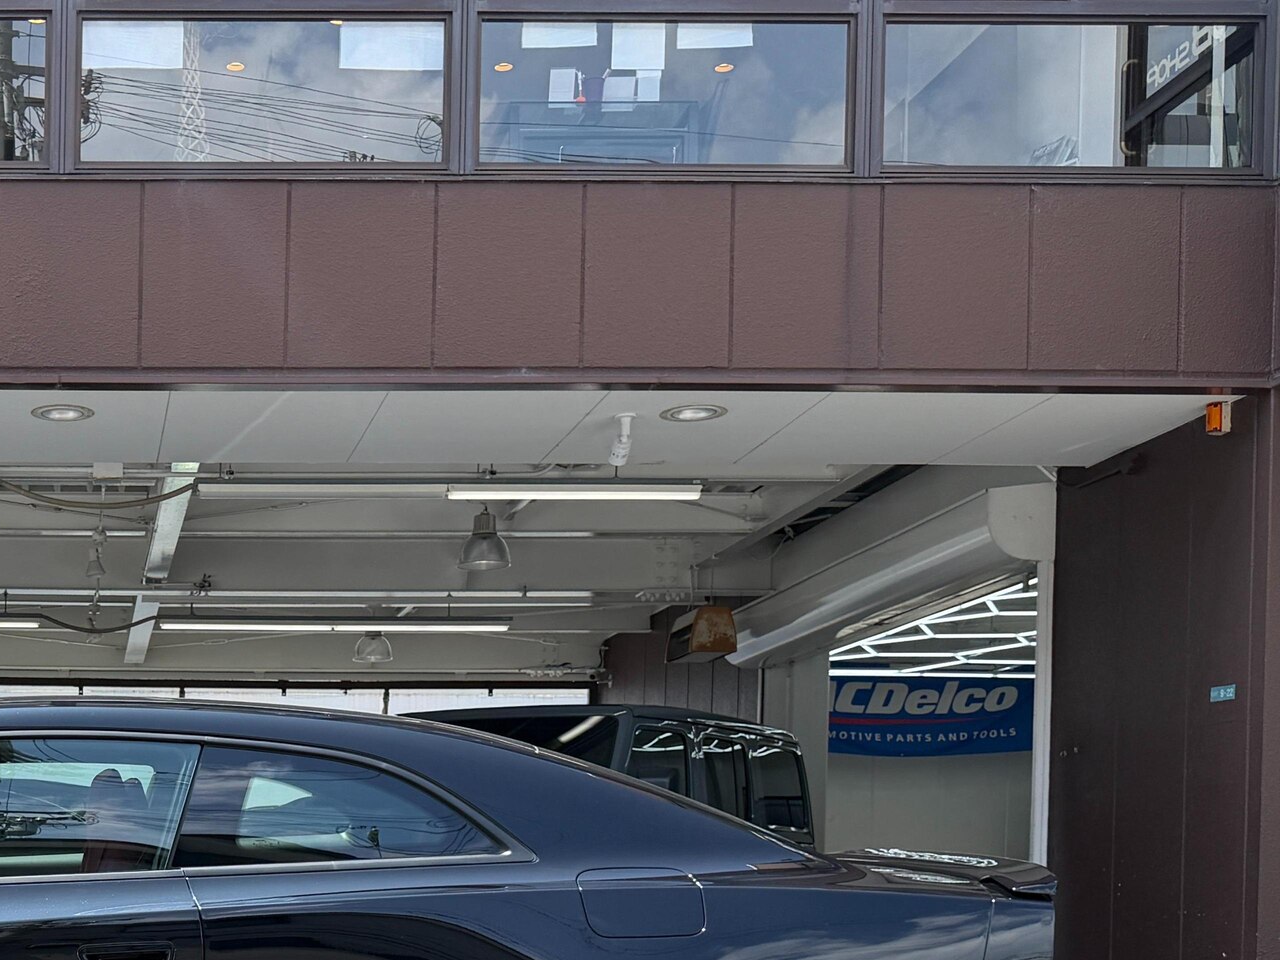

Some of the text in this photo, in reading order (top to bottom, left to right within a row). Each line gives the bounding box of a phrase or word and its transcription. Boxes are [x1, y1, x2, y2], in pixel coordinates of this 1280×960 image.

[829, 681, 1019, 715] CDelco
[886, 733, 932, 743] PARTS
[937, 731, 968, 742] AND
[972, 727, 1017, 740] TOOLS
